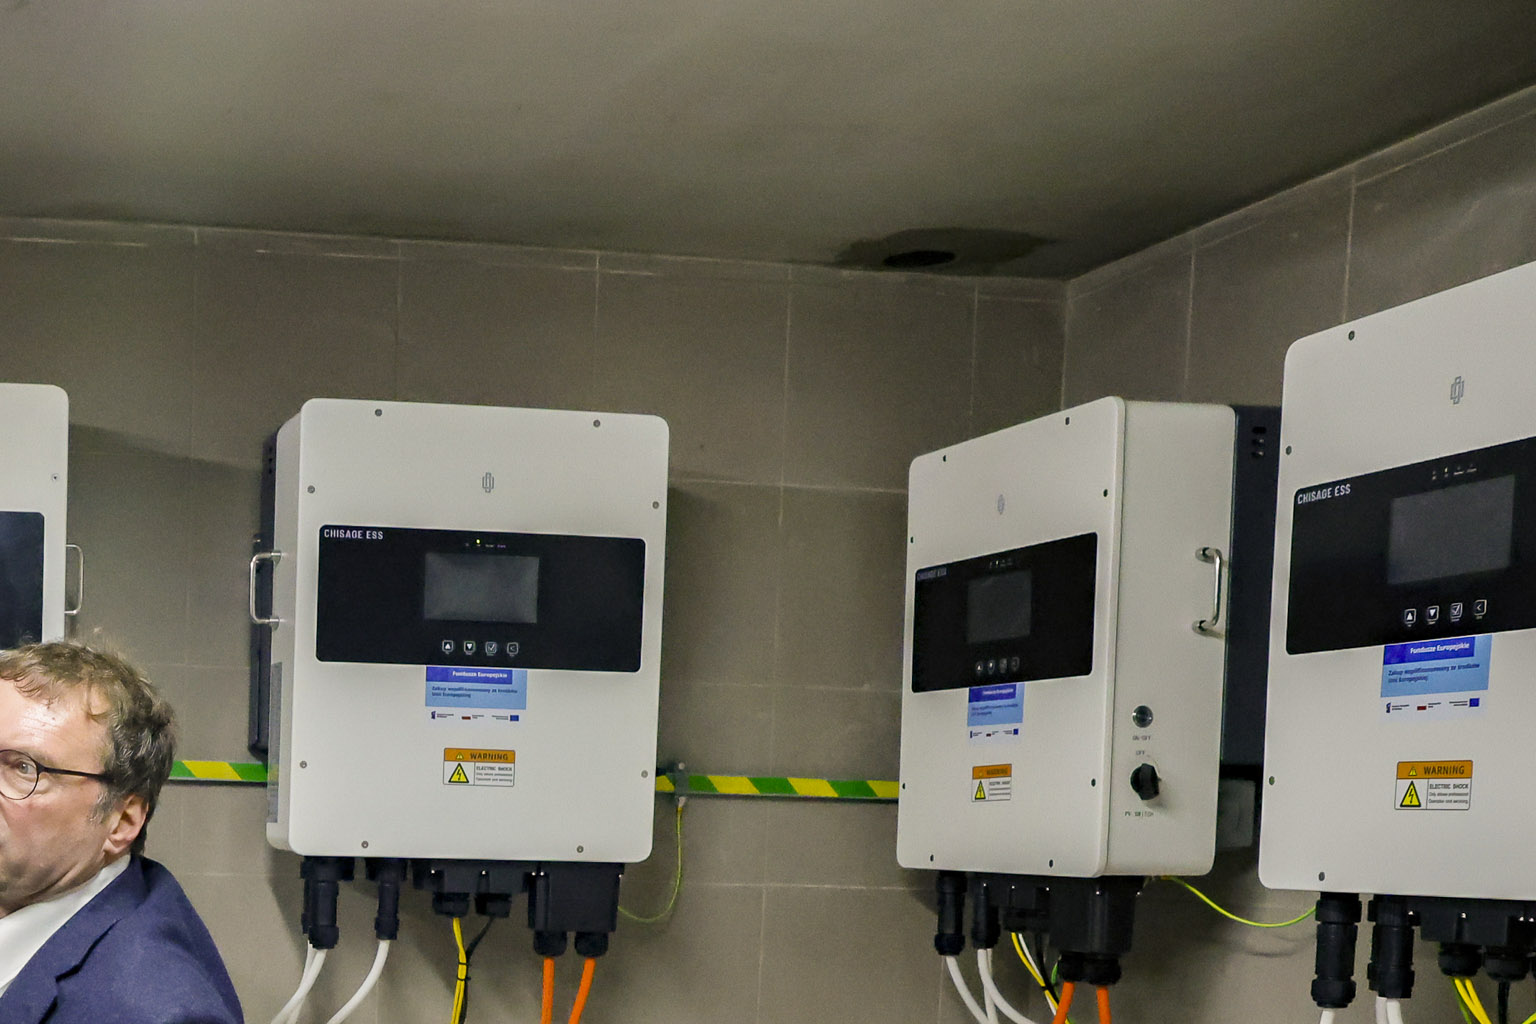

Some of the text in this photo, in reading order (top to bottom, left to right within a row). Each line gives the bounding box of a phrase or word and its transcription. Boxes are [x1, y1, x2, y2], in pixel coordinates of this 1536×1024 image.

[1297, 483, 1351, 505] CHISAGE ESS
[324, 529, 384, 540] CHISAGE ESS
[469, 752, 509, 761] WARNING
[1424, 765, 1465, 775] WARNING
